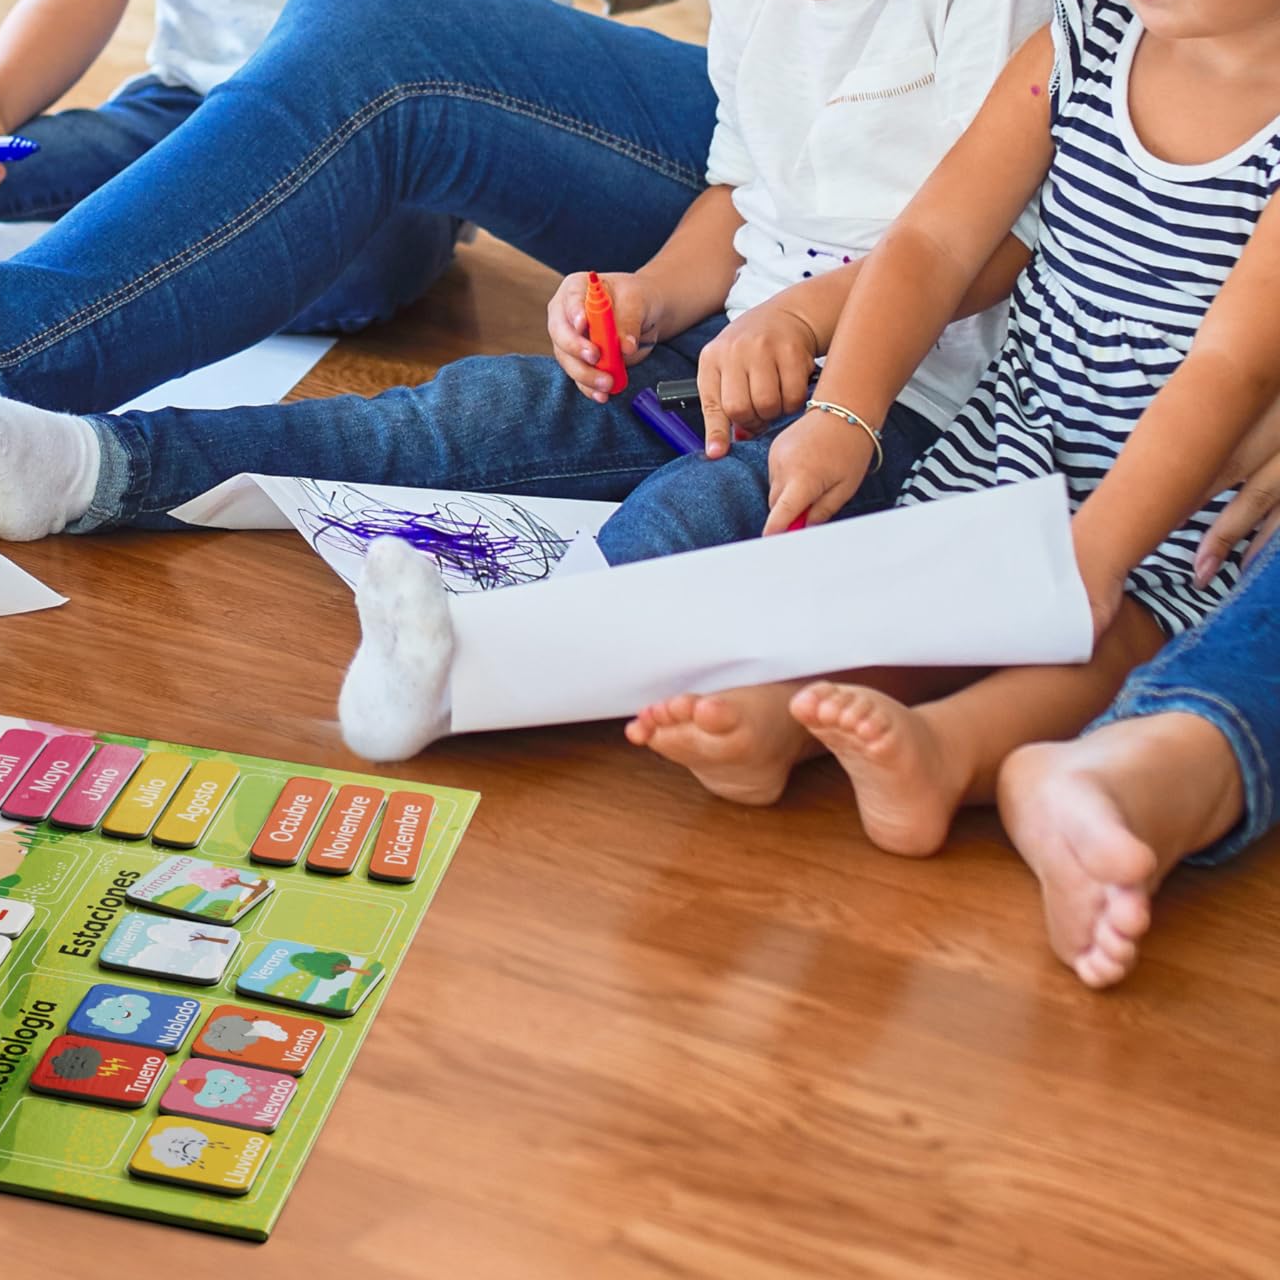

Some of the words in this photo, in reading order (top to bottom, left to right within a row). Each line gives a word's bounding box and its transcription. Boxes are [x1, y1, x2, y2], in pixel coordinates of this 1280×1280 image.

[29, 759, 70, 794] Mayo
[81, 767, 119, 802] Junio
[132, 777, 167, 809] Julio
[176, 780, 219, 823] Agosto
[270, 793, 313, 843] Octubre
[321, 795, 371, 860] Noviembre
[384, 803, 423, 866] Diciembre
[133, 856, 193, 900] Primavera
[58, 869, 141, 959] Estaciones
[249, 946, 289, 981] Verano
[156, 999, 199, 1047] Nublado
[282, 1027, 318, 1064] Viento
[125, 1055, 162, 1095] Trueno
[253, 1078, 294, 1123] Nevado
[223, 1135, 265, 1186] Lluvioso
